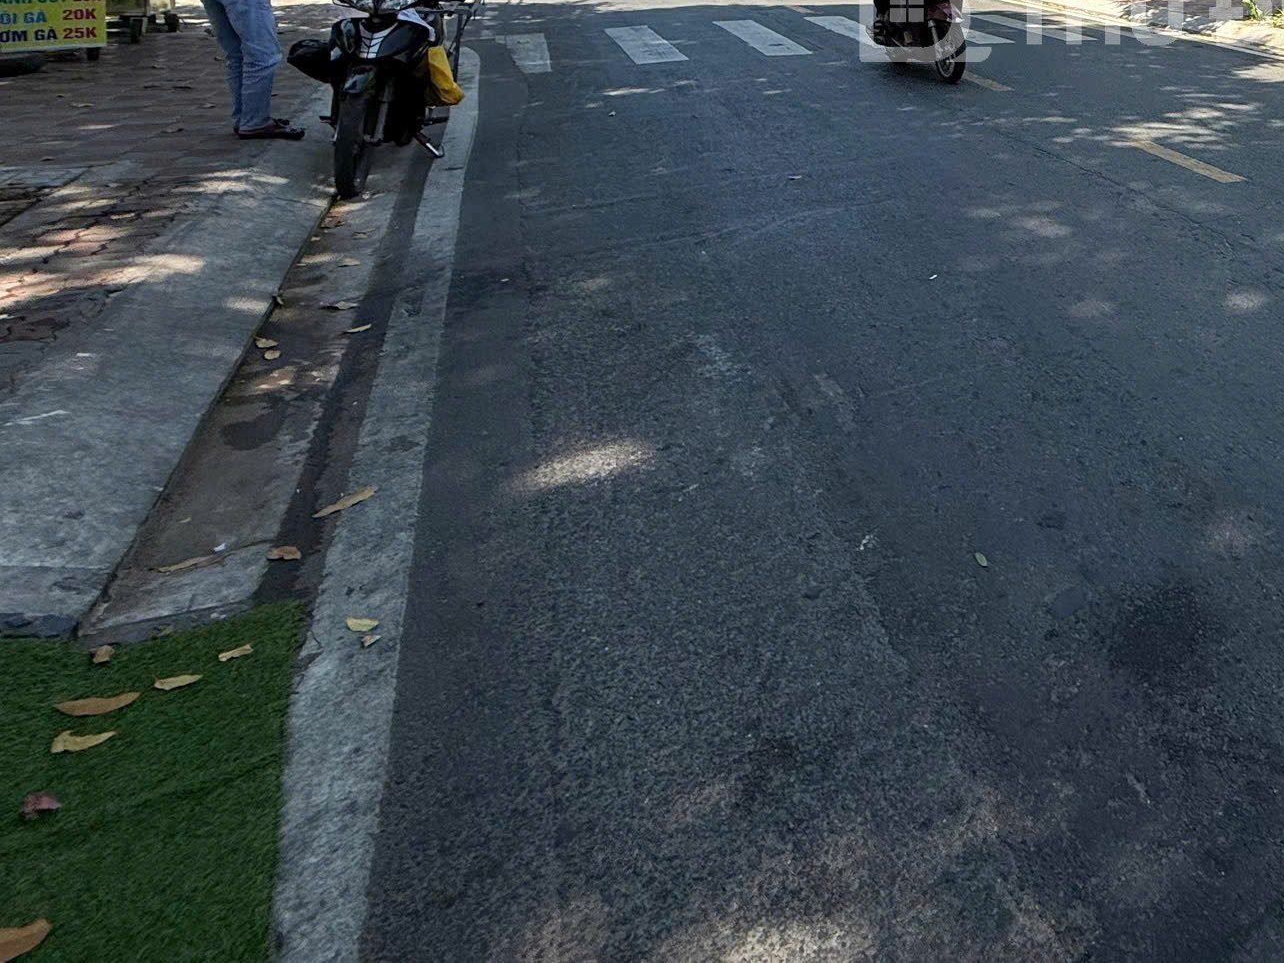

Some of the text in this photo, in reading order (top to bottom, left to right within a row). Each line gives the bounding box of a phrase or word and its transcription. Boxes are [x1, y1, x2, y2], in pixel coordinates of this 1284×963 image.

[0, 9, 17, 25] ÔI
[62, 8, 97, 21] 20K
[0, 25, 97, 43] ƠM GÀ 25K
